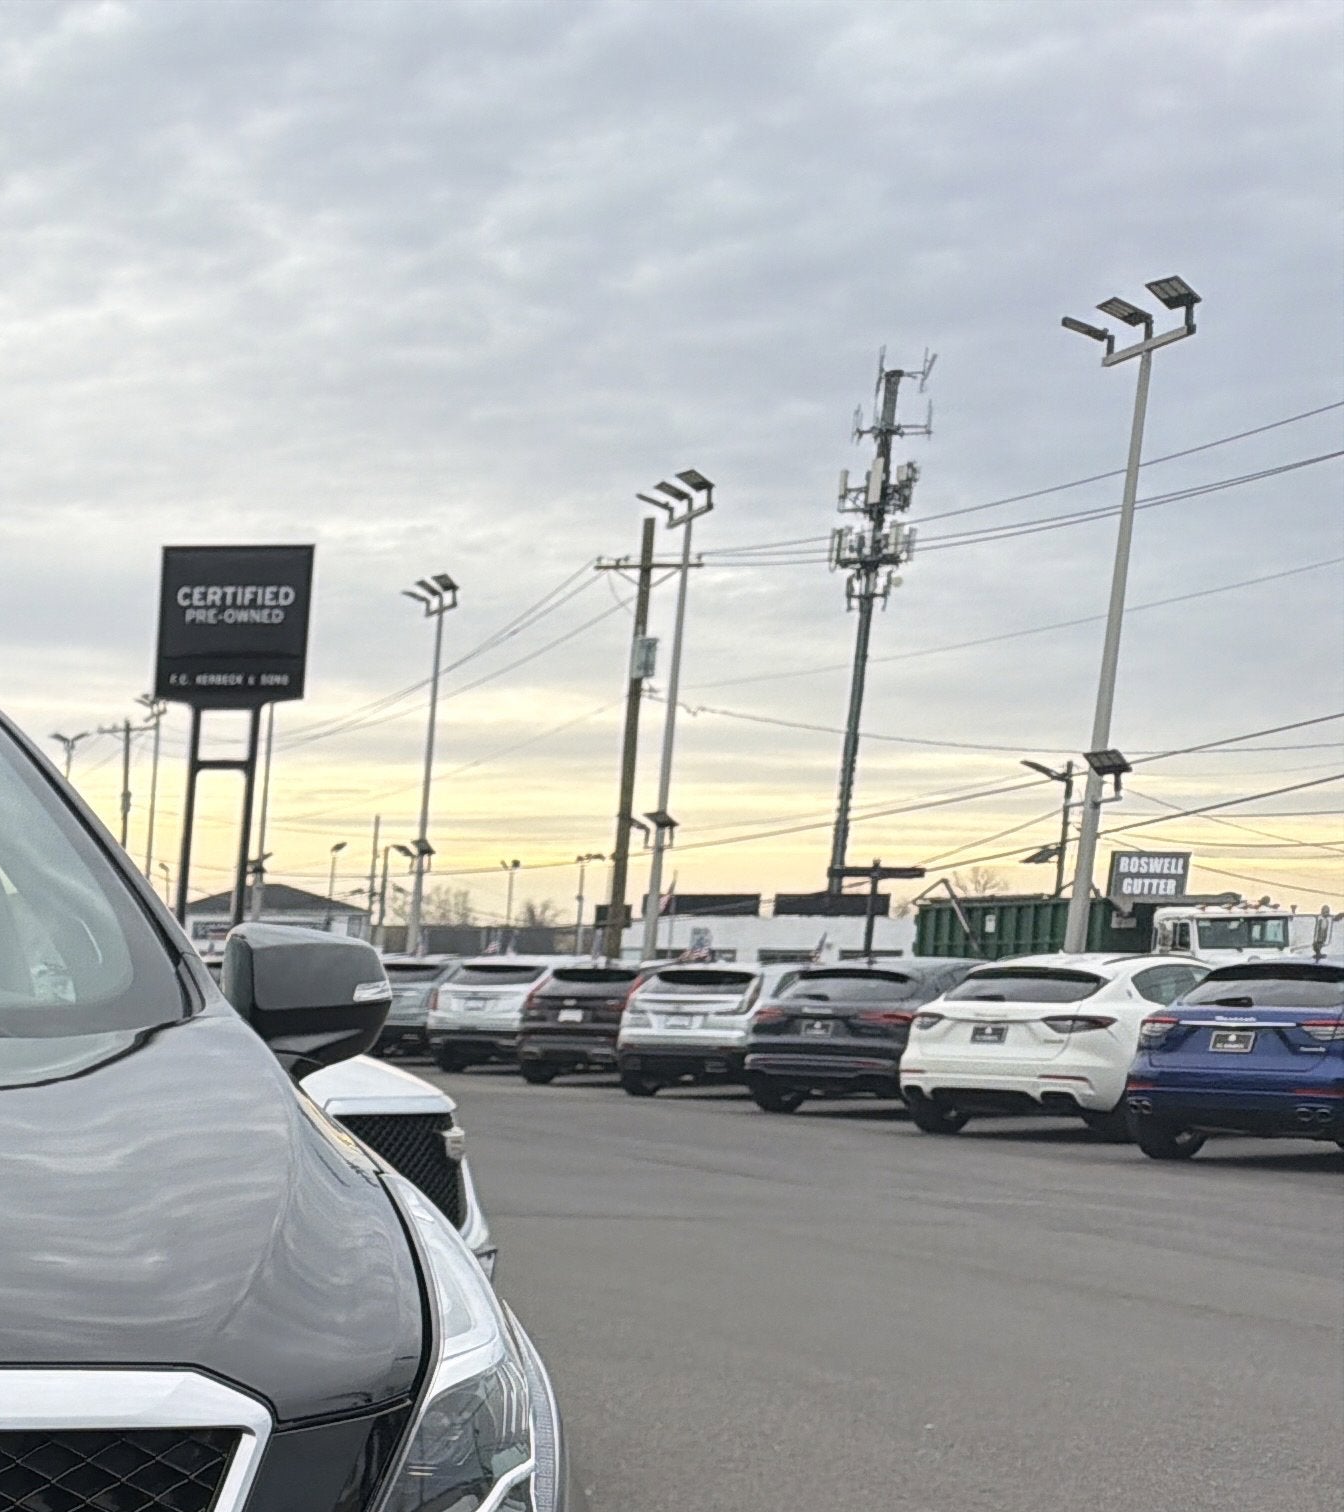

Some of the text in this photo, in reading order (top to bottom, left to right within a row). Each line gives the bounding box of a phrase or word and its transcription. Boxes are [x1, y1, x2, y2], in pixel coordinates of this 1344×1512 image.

[176, 585, 296, 607] CERTIFIED
[185, 608, 285, 624] PRE-OWNED
[1122, 877, 1176, 895] GUTTER
